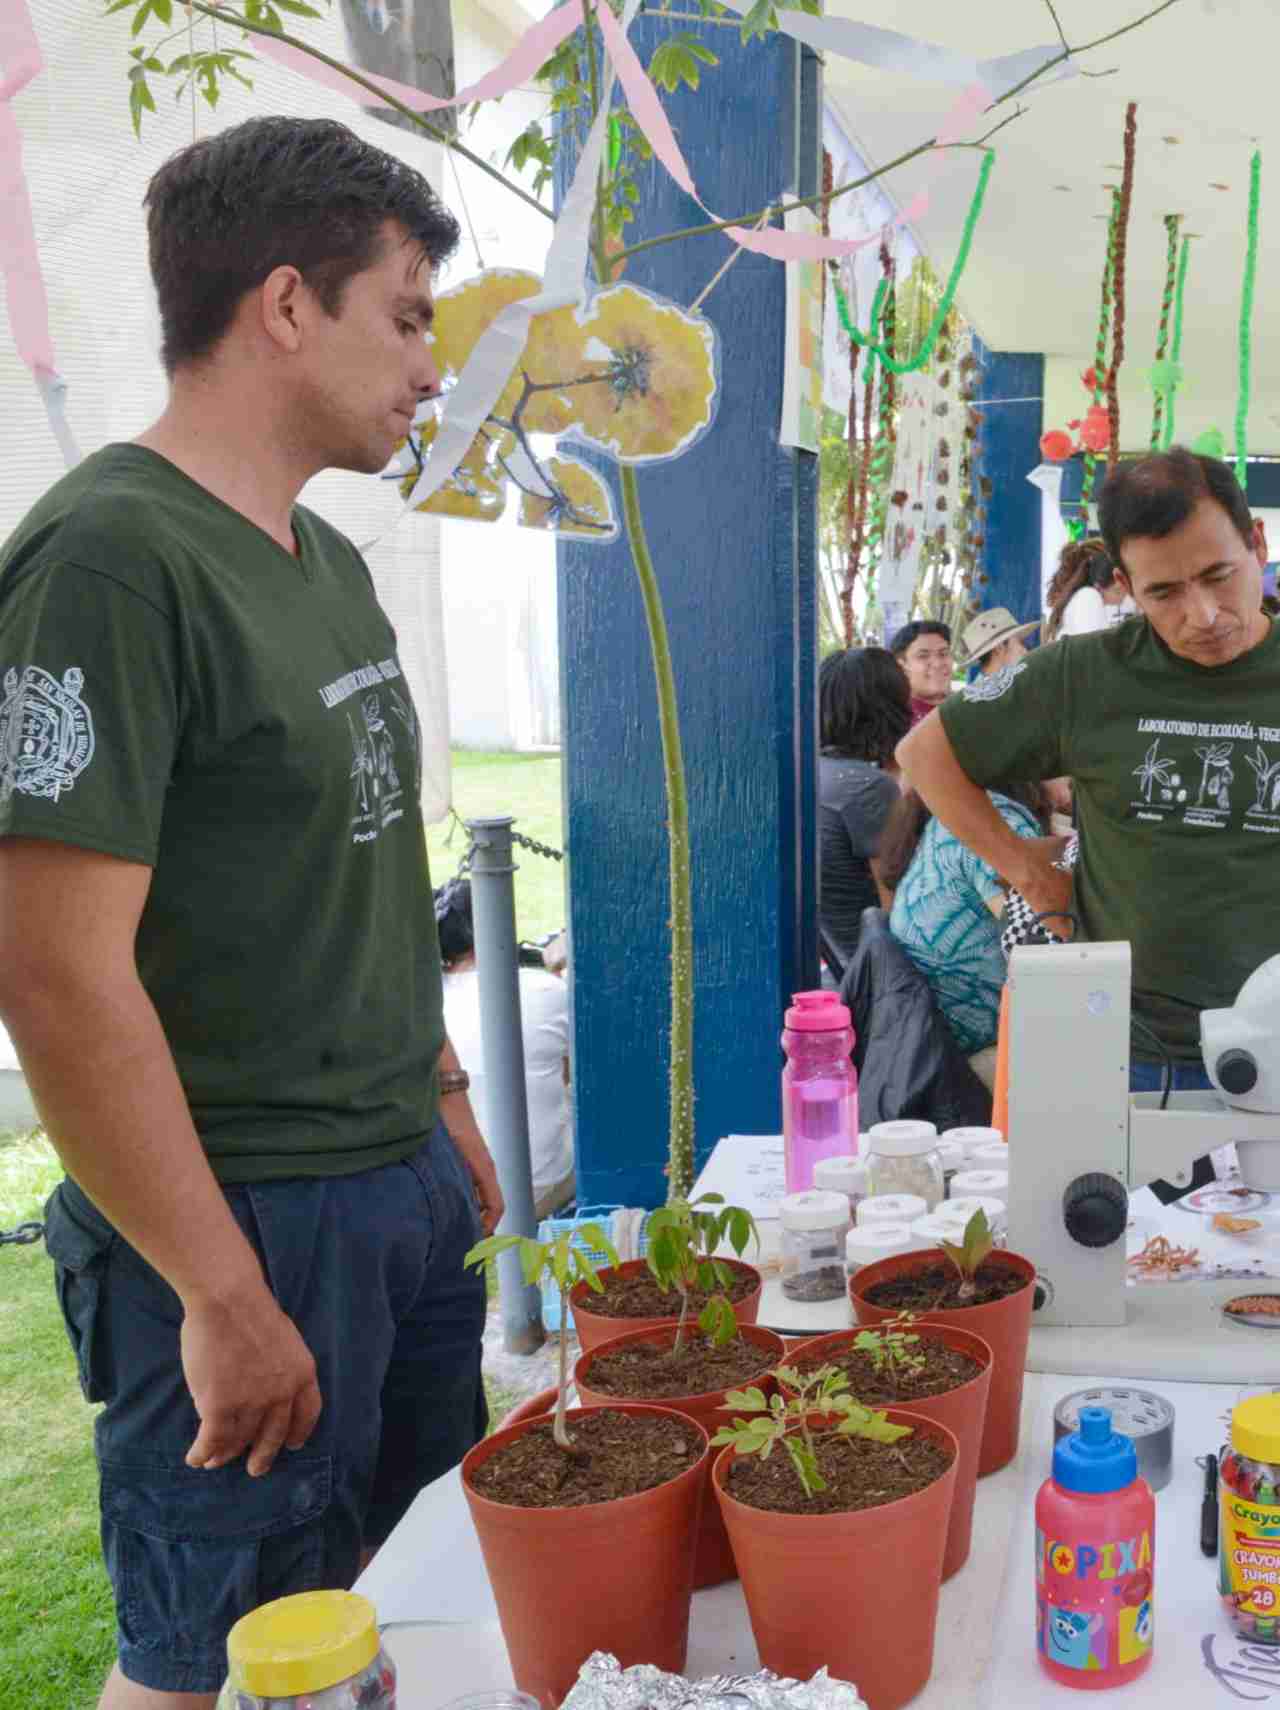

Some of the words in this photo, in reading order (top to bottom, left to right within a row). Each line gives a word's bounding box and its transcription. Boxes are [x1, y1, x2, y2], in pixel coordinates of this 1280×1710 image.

[1137, 718, 1197, 736] LABORATORIO
[1197, 722, 1210, 737] DE
[1252, 1590, 1274, 1607] 28
